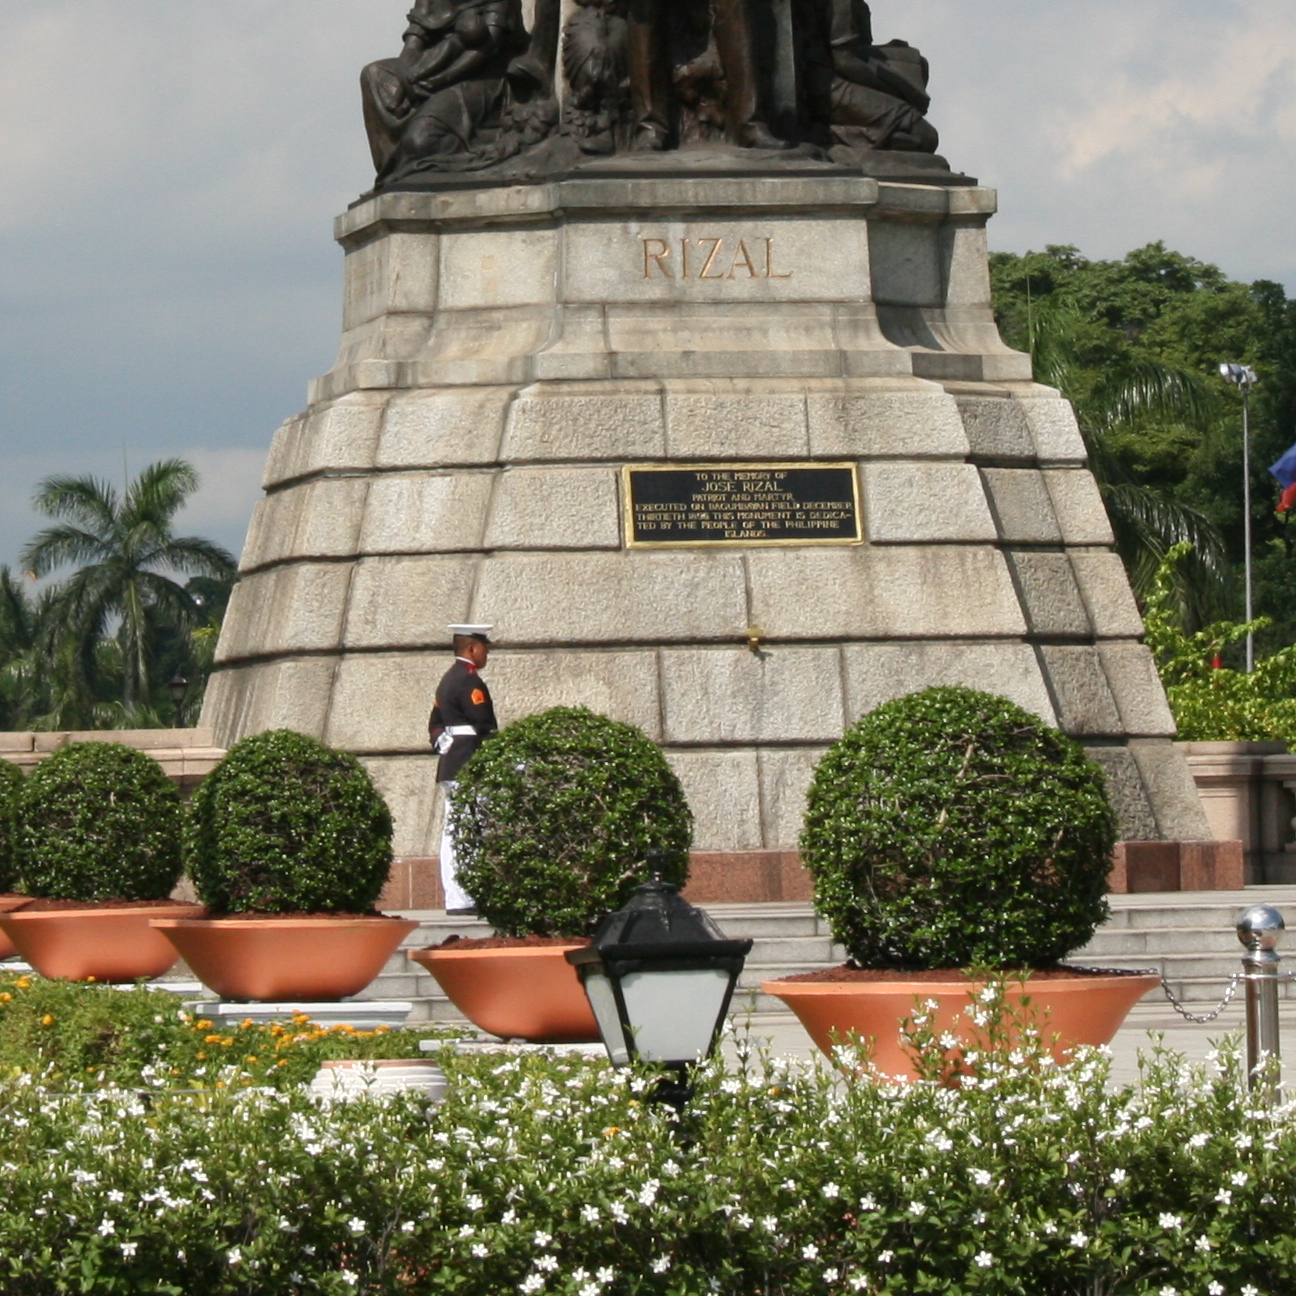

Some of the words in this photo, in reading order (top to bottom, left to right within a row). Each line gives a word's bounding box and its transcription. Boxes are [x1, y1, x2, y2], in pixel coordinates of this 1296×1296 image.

[642, 236, 794, 280] RIZAL
[695, 473, 708, 481] TO
[712, 472, 731, 480] THE
[734, 472, 770, 480] MEMORY
[775, 472, 787, 480] OF
[743, 481, 784, 492] RIZAL
[692, 493, 727, 501] PATRIOT
[731, 493, 751, 501] AND
[635, 503, 687, 511] EXECUTED
[691, 503, 705, 511] ON
[709, 502, 769, 510] BAGUMBAYAN
[771, 502, 800, 510] FIELD
[803, 502, 853, 510] DECEMBER
[637, 513, 686, 521] THIRTIETH
[713, 512, 734, 520] THIS
[737, 512, 791, 520] MONUMENT
[810, 511, 852, 519] DEDICA-
[637, 522, 656, 530] TED
[660, 522, 672, 530] BY
[677, 521, 697, 530] THE
[701, 521, 738, 529] PEOPLE
[743, 521, 755, 529] OF
[761, 521, 781, 529] THE
[785, 521, 840, 529] PHILIPPINE
